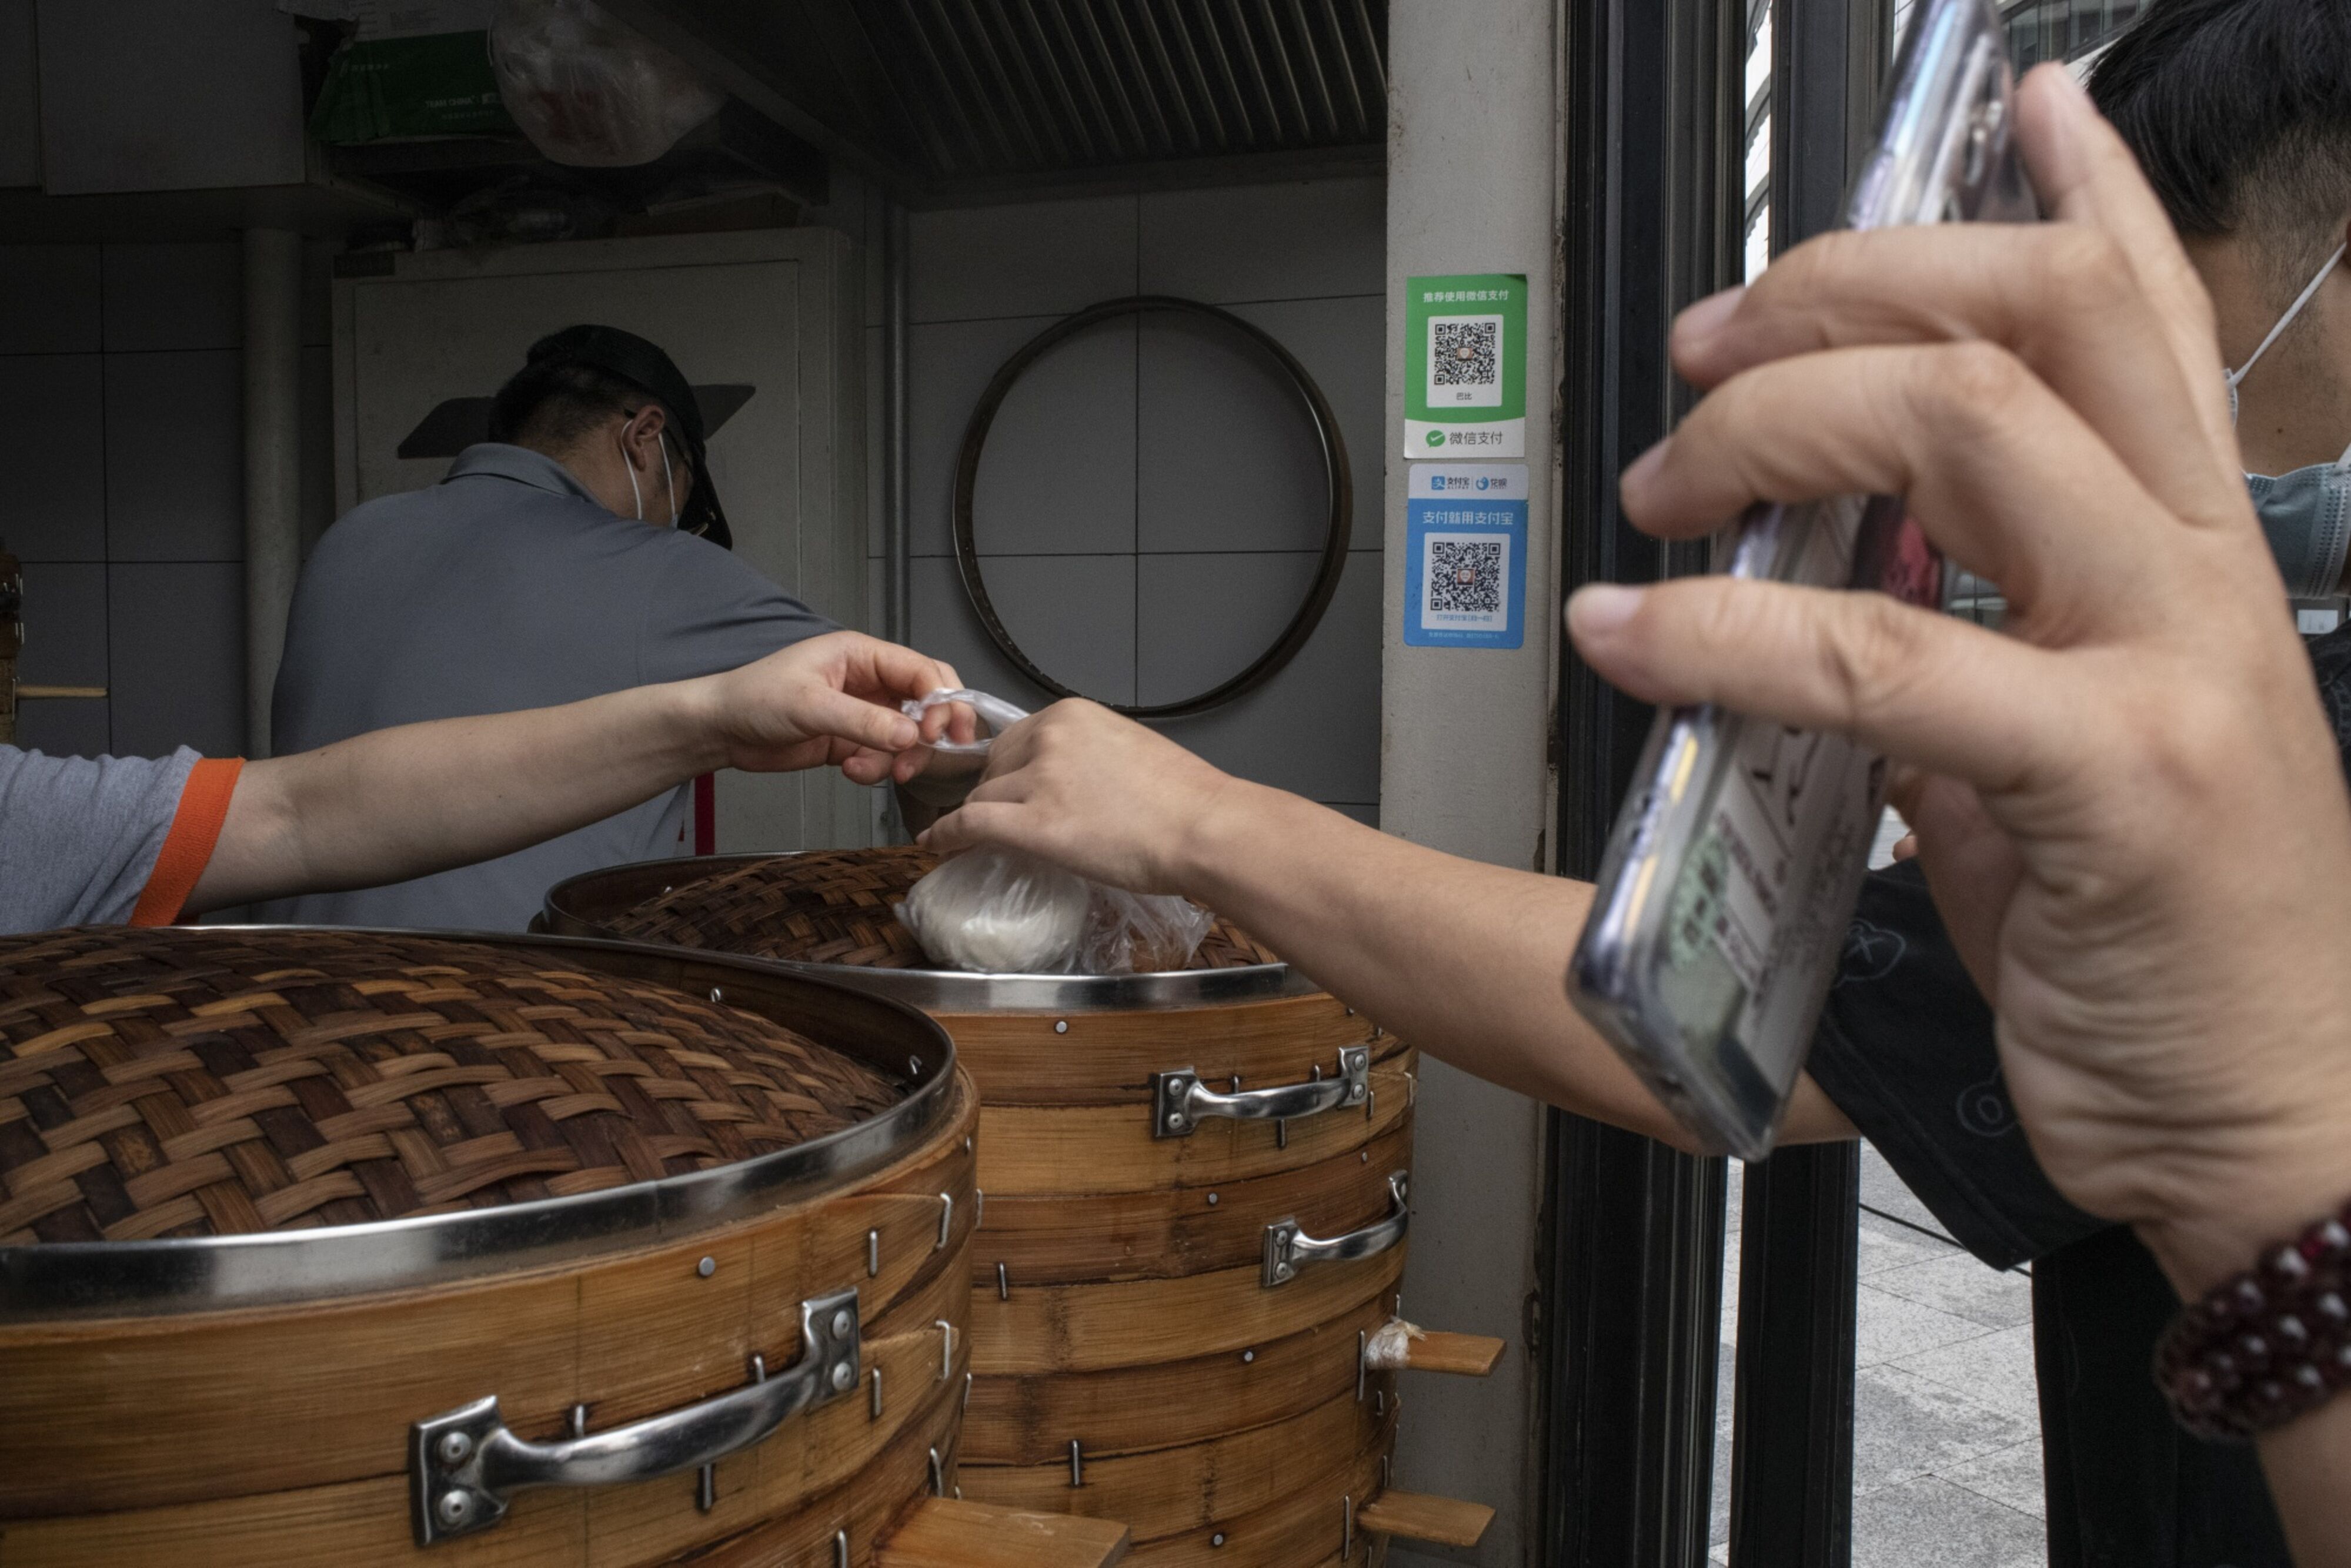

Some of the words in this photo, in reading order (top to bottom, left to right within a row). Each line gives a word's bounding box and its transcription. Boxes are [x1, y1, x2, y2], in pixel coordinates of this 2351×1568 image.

[1423, 290, 1508, 303] 推荐使用微信支付
[1456, 392, 1472, 400] 巴比
[1450, 432, 1503, 444] 微信支付
[1447, 477, 1470, 486] 支付宝
[1422, 511, 1514, 525] 支付就用支付宝
